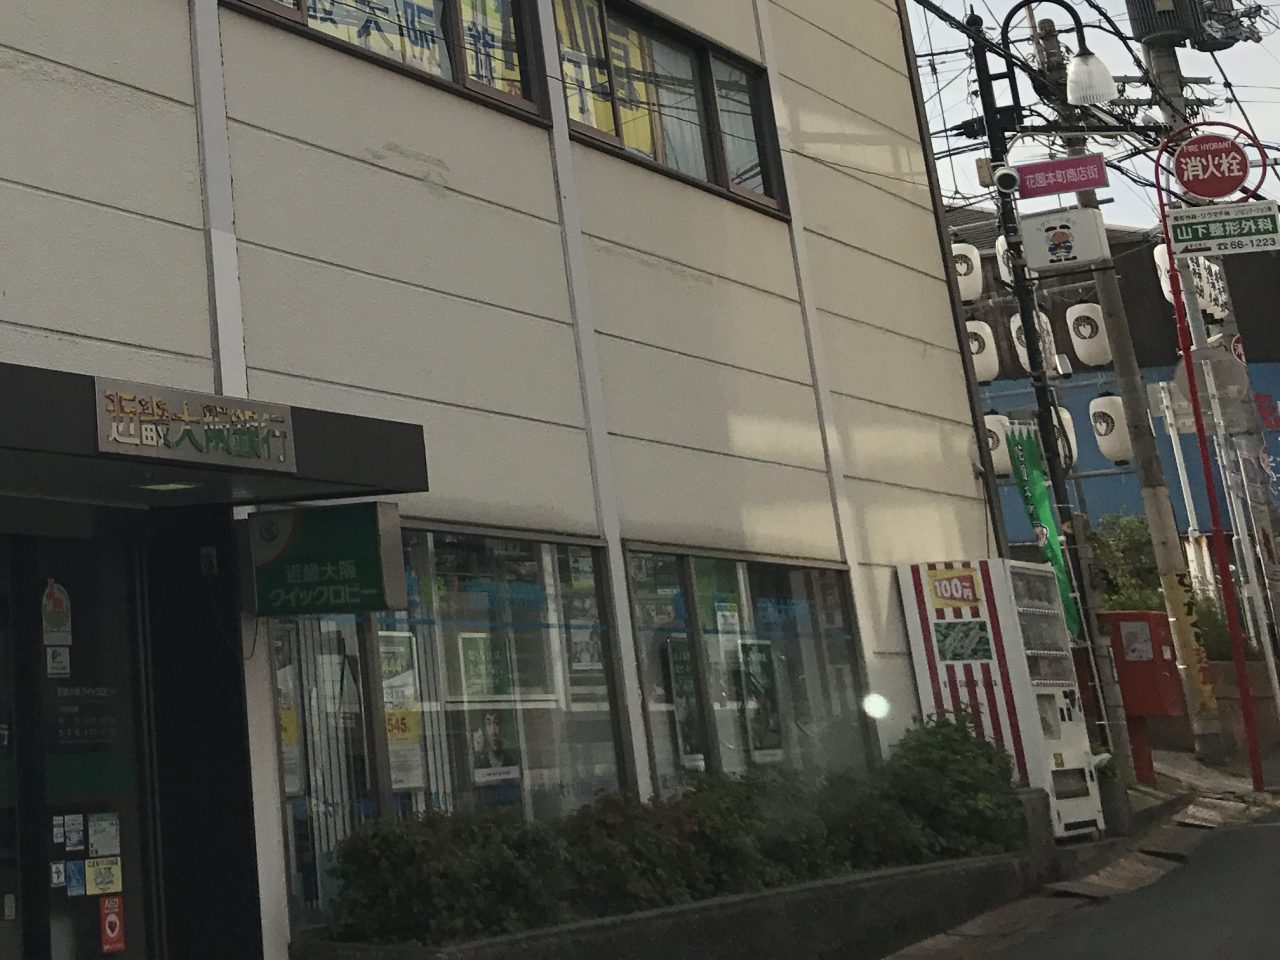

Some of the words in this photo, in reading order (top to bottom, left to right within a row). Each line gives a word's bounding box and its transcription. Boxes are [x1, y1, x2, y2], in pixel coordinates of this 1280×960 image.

[1183, 144, 1199, 153] FIRE
[1201, 140, 1233, 152] HYDRANT
[1024, 164, 1099, 189] 花園本町商店街
[1180, 151, 1244, 182] 消火栓
[1176, 217, 1273, 240] 山下整形外科
[269, 584, 378, 608] クイックロビー
